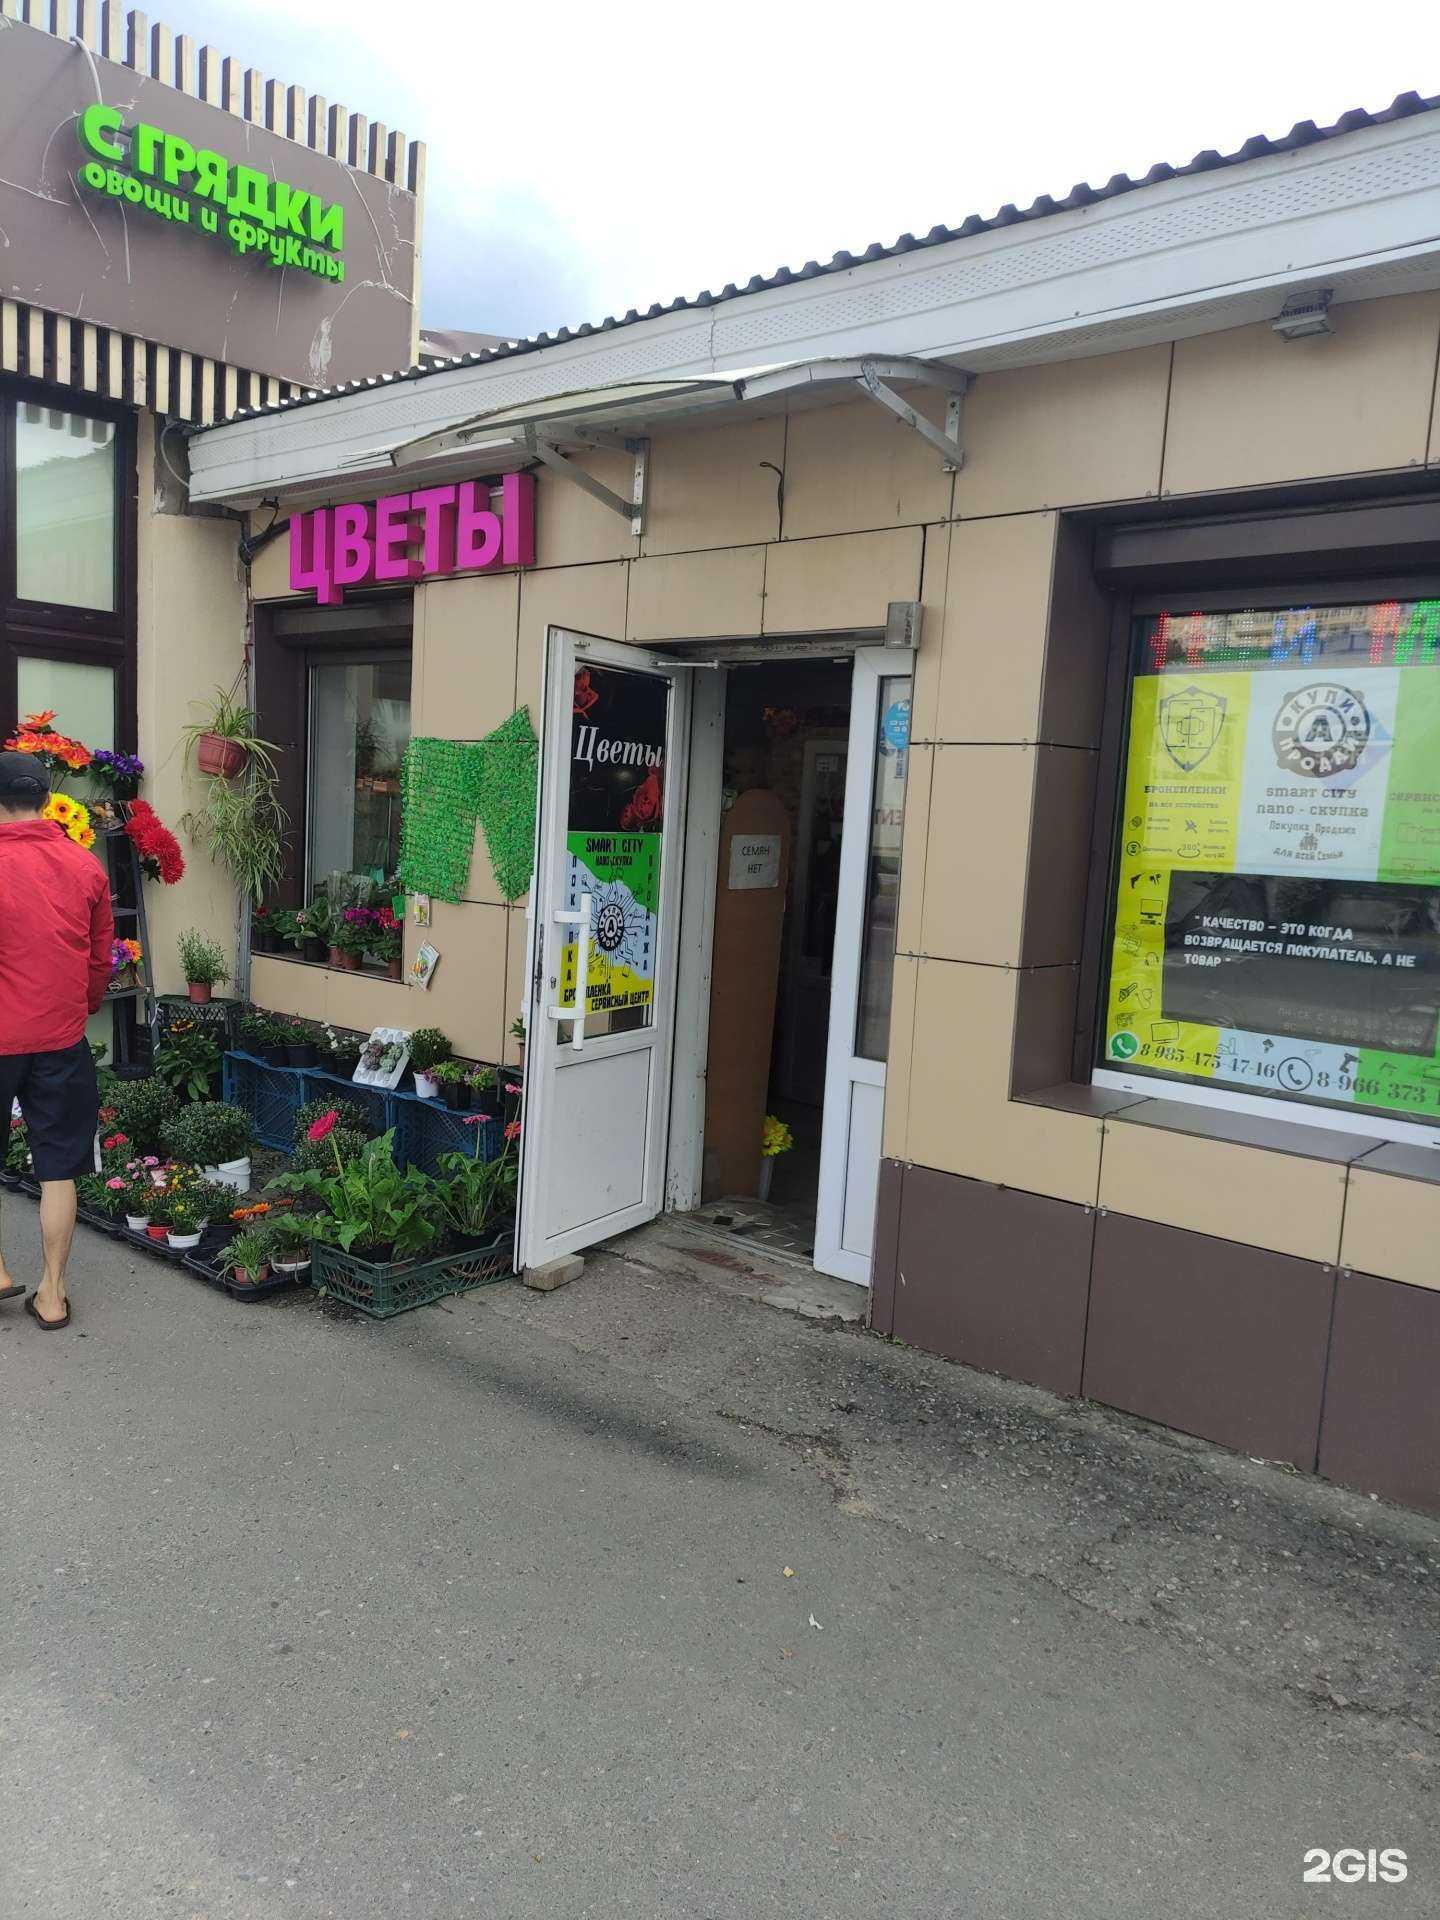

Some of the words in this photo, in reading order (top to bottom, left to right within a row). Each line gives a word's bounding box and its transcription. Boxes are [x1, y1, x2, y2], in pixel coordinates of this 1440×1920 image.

[80, 104, 124, 162] С
[133, 122, 345, 251] ГРЯДКИ
[199, 206, 219, 233] и
[289, 472, 537, 606] ЦВЕТЫ
[572, 724, 664, 773] Цветы
[585, 838, 617, 852] SMART
[621, 838, 644, 851] CITY
[566, 855, 578, 982] ПОКПКА
[1202, 916, 1265, 932] КАЧЕСТВО
[1280, 922, 1305, 936] ЭТО
[1308, 925, 1354, 941] КОГДА
[1184, 934, 1283, 955] ВОЗВРАЩАЕТСЯ
[1381, 955, 1393, 966] А
[1396, 955, 1416, 968] НЕ
[1184, 953, 1221, 968] ТОВАР
